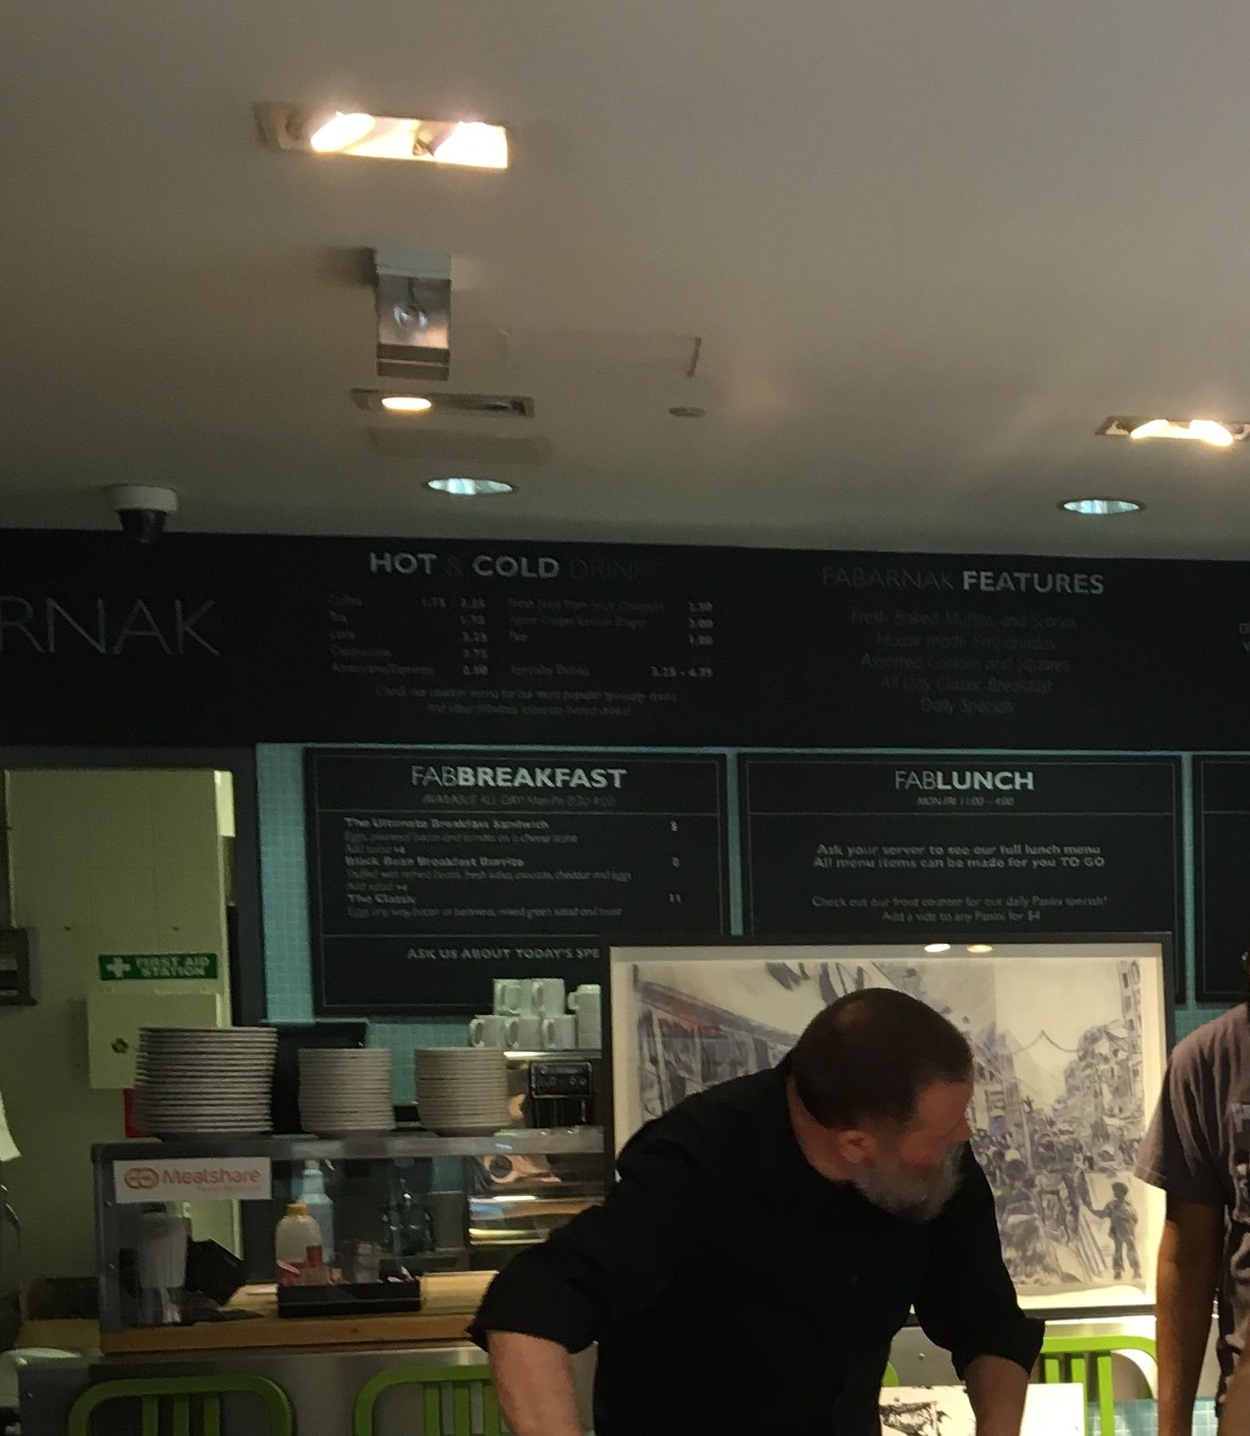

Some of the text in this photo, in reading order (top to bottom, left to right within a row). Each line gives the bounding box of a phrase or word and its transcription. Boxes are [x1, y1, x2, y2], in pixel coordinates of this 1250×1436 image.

[369, 552, 437, 574] HOT
[472, 555, 559, 578] COLD
[821, 566, 1104, 594] FABARNAK FEATURES
[0, 597, 220, 655] RNAK
[411, 765, 627, 789] FABBREAKFAST
[895, 770, 1035, 791] FABLUNCH
[343, 817, 549, 830] The Ultimate Breakfast Sandwich
[816, 844, 1101, 857] Ask your server to see our full lunch menu
[345, 856, 380, 866] Black
[382, 856, 414, 866] Bean
[416, 856, 477, 866] Breakfast
[813, 857, 1105, 870] All menu items can be made for you TO GO
[347, 893, 373, 903] The
[374, 893, 418, 904] Classic
[812, 896, 847, 907] Check
[871, 898, 891, 907] our
[892, 897, 919, 907] front
[921, 897, 963, 907] counter
[965, 896, 982, 907] for
[984, 898, 1004, 907] our
[1006, 896, 1029, 909] daily
[1031, 896, 1063, 907] Panini
[882, 911, 904, 922] Add
[939, 912, 952, 922] to
[975, 911, 1006, 922] Panini
[1008, 911, 1025, 922] for
[1027, 910, 1042, 922] $4
[407, 948, 436, 960] ASK
[439, 948, 458, 960] US
[461, 948, 511, 960] ABOUT
[514, 947, 575, 961] TODAY'S
[136, 956, 210, 967] FIRST AID
[141, 966, 207, 977] STATION
